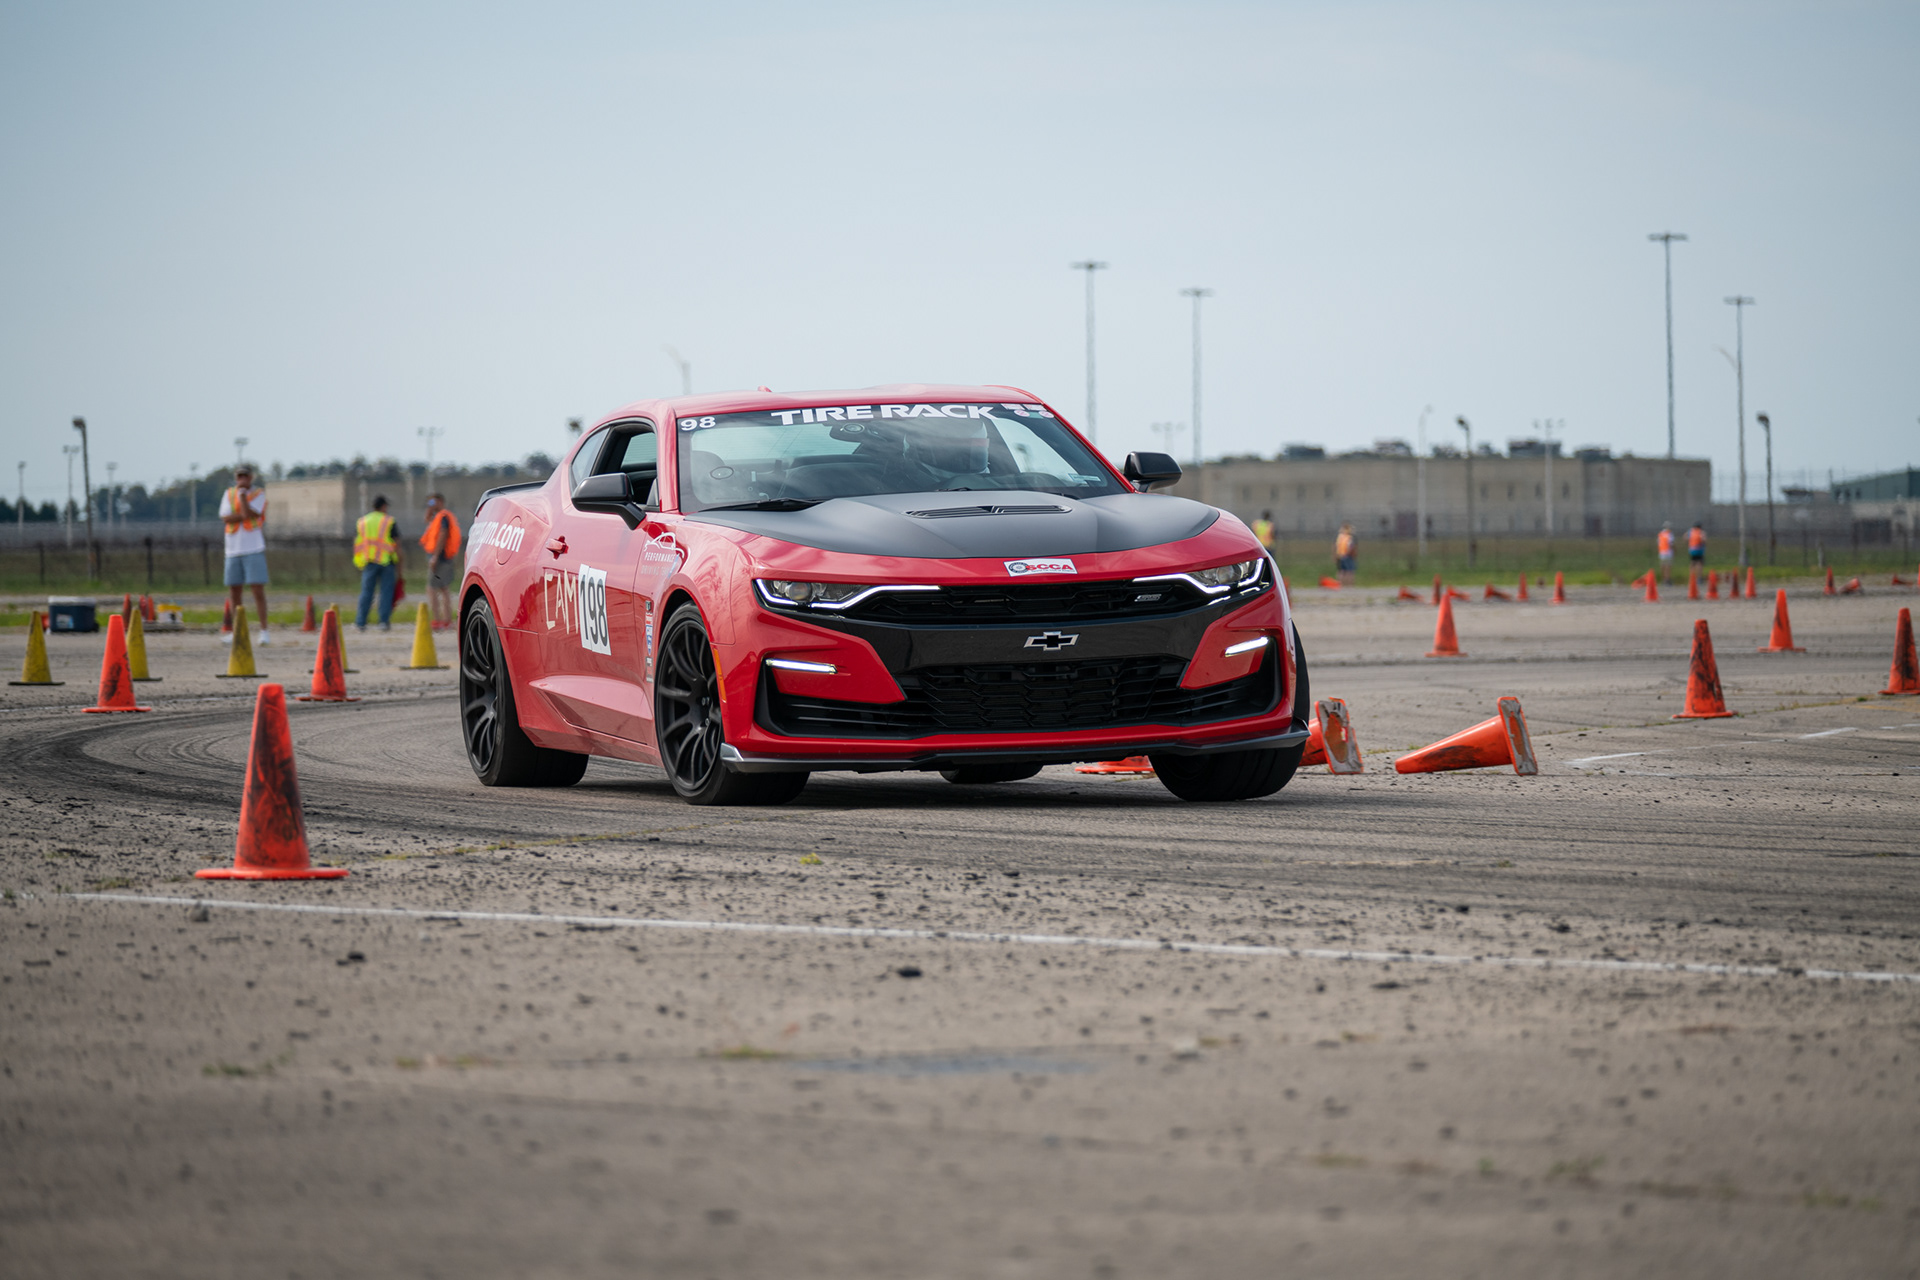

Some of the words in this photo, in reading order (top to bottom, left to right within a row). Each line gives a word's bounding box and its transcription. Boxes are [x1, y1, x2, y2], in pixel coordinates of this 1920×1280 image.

[680, 416, 716, 431] 98
[771, 405, 874, 425] TIRE
[880, 404, 999, 420] RACK
[1026, 563, 1074, 571] SCCA
[544, 568, 579, 635] CAM
[580, 574, 608, 647] 198
